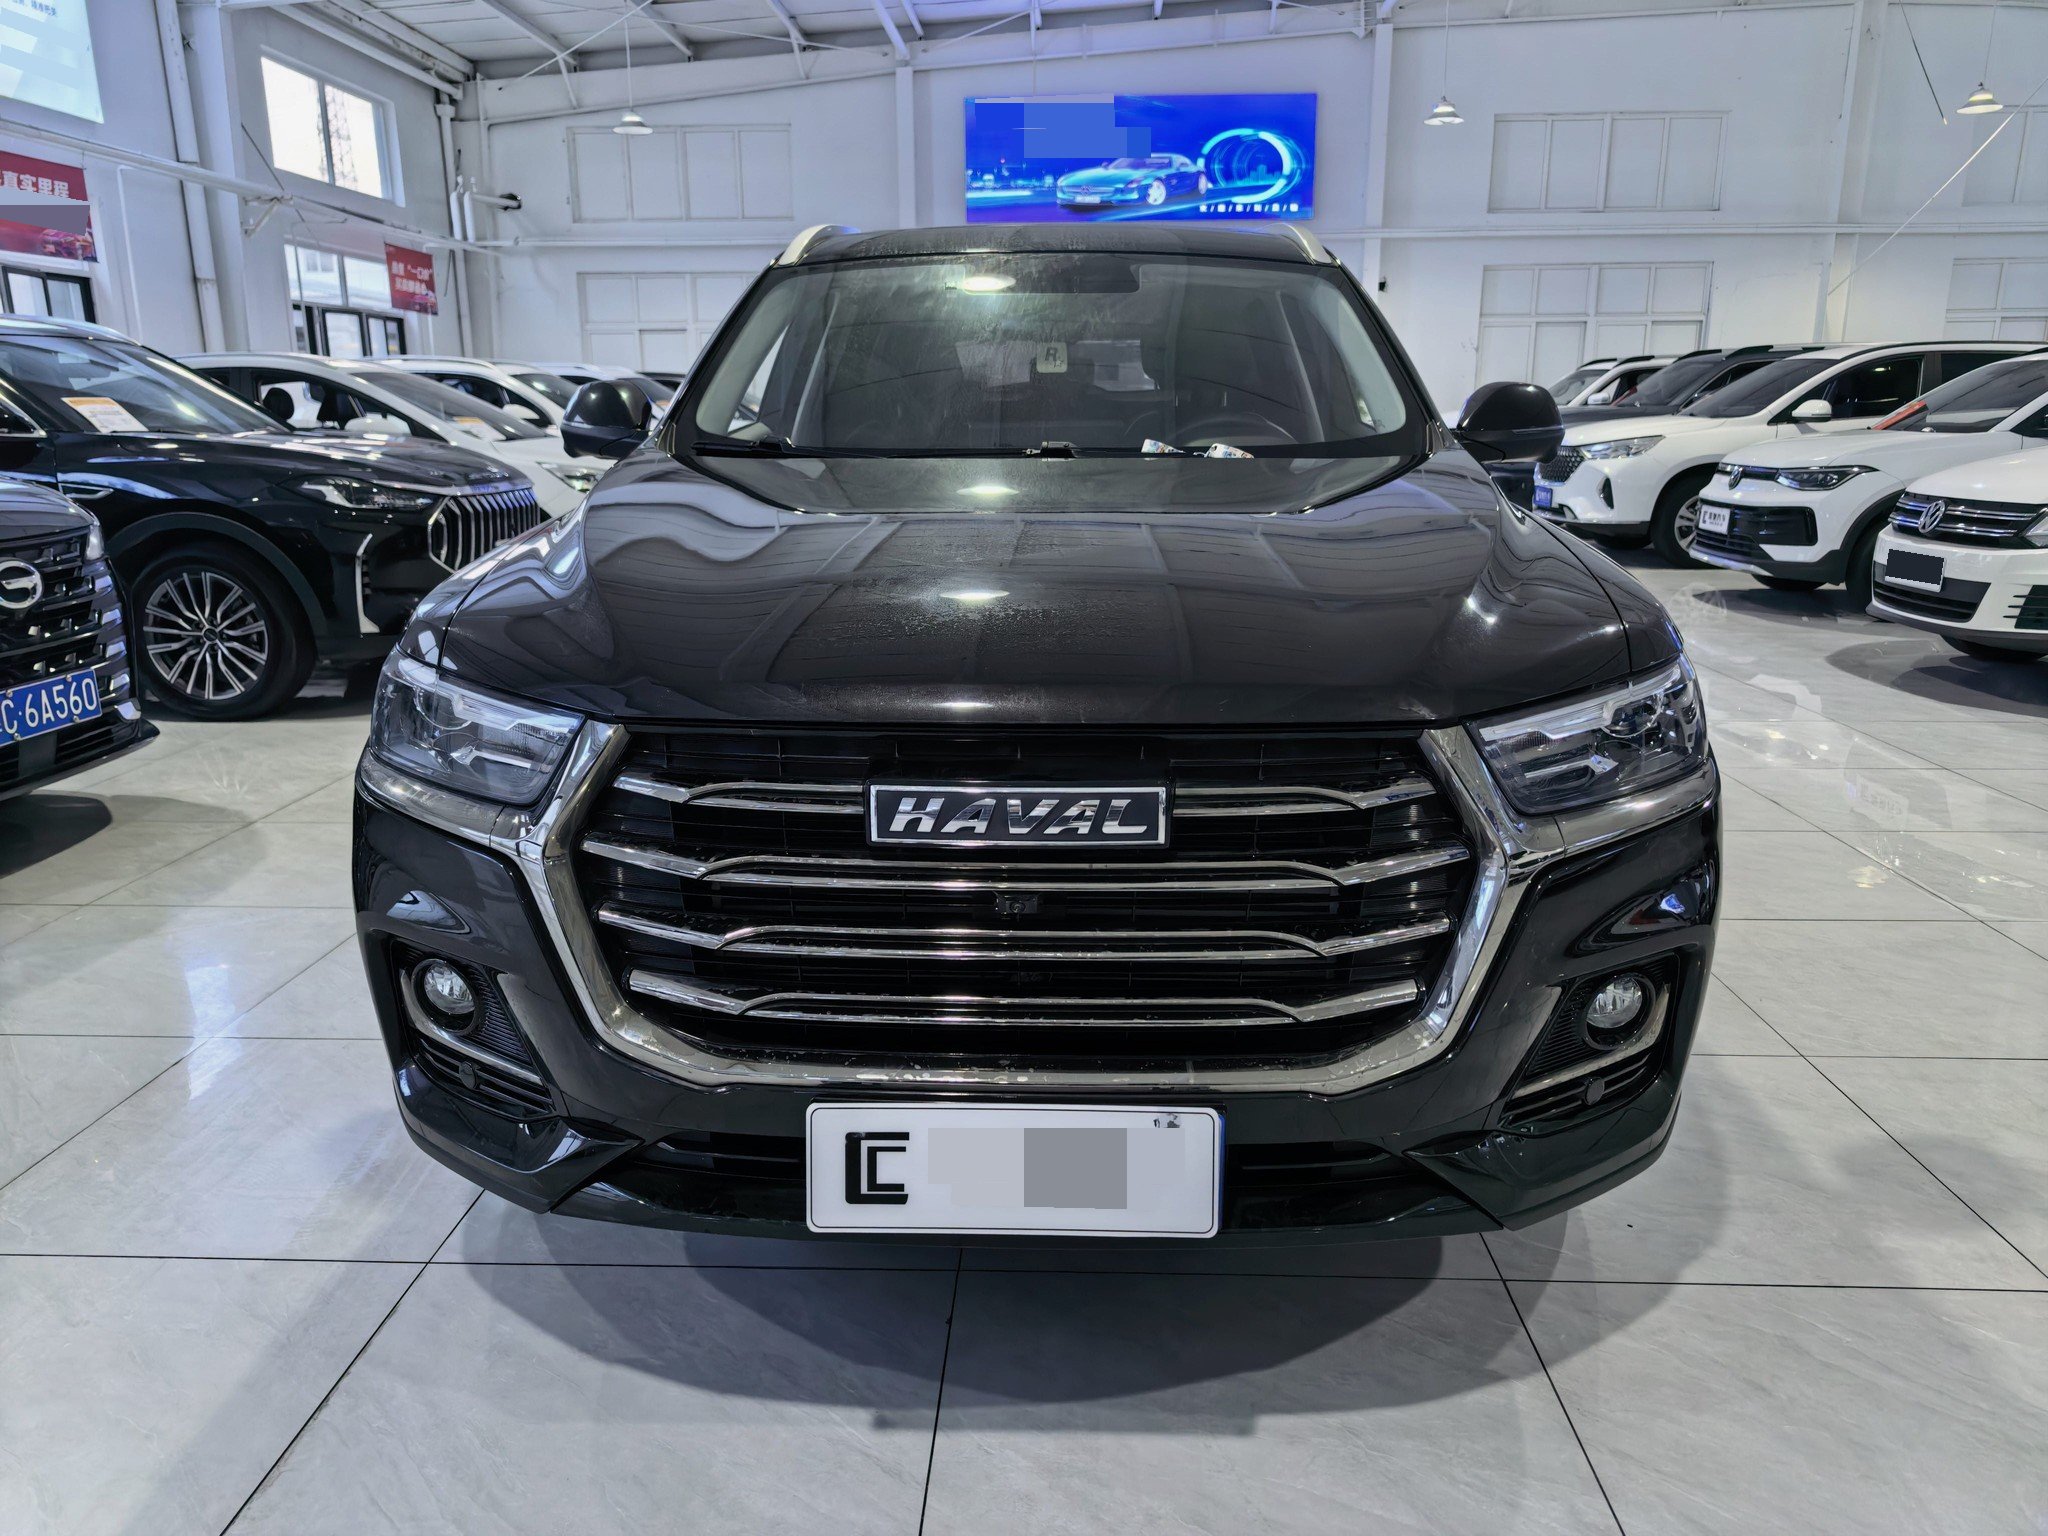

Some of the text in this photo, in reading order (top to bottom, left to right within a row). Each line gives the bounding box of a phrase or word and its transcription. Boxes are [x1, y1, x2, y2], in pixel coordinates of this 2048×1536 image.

[0, 170, 69, 198] 真实里程
[0, 677, 97, 734] C·6A560
[888, 797, 1148, 835] HAVAL
